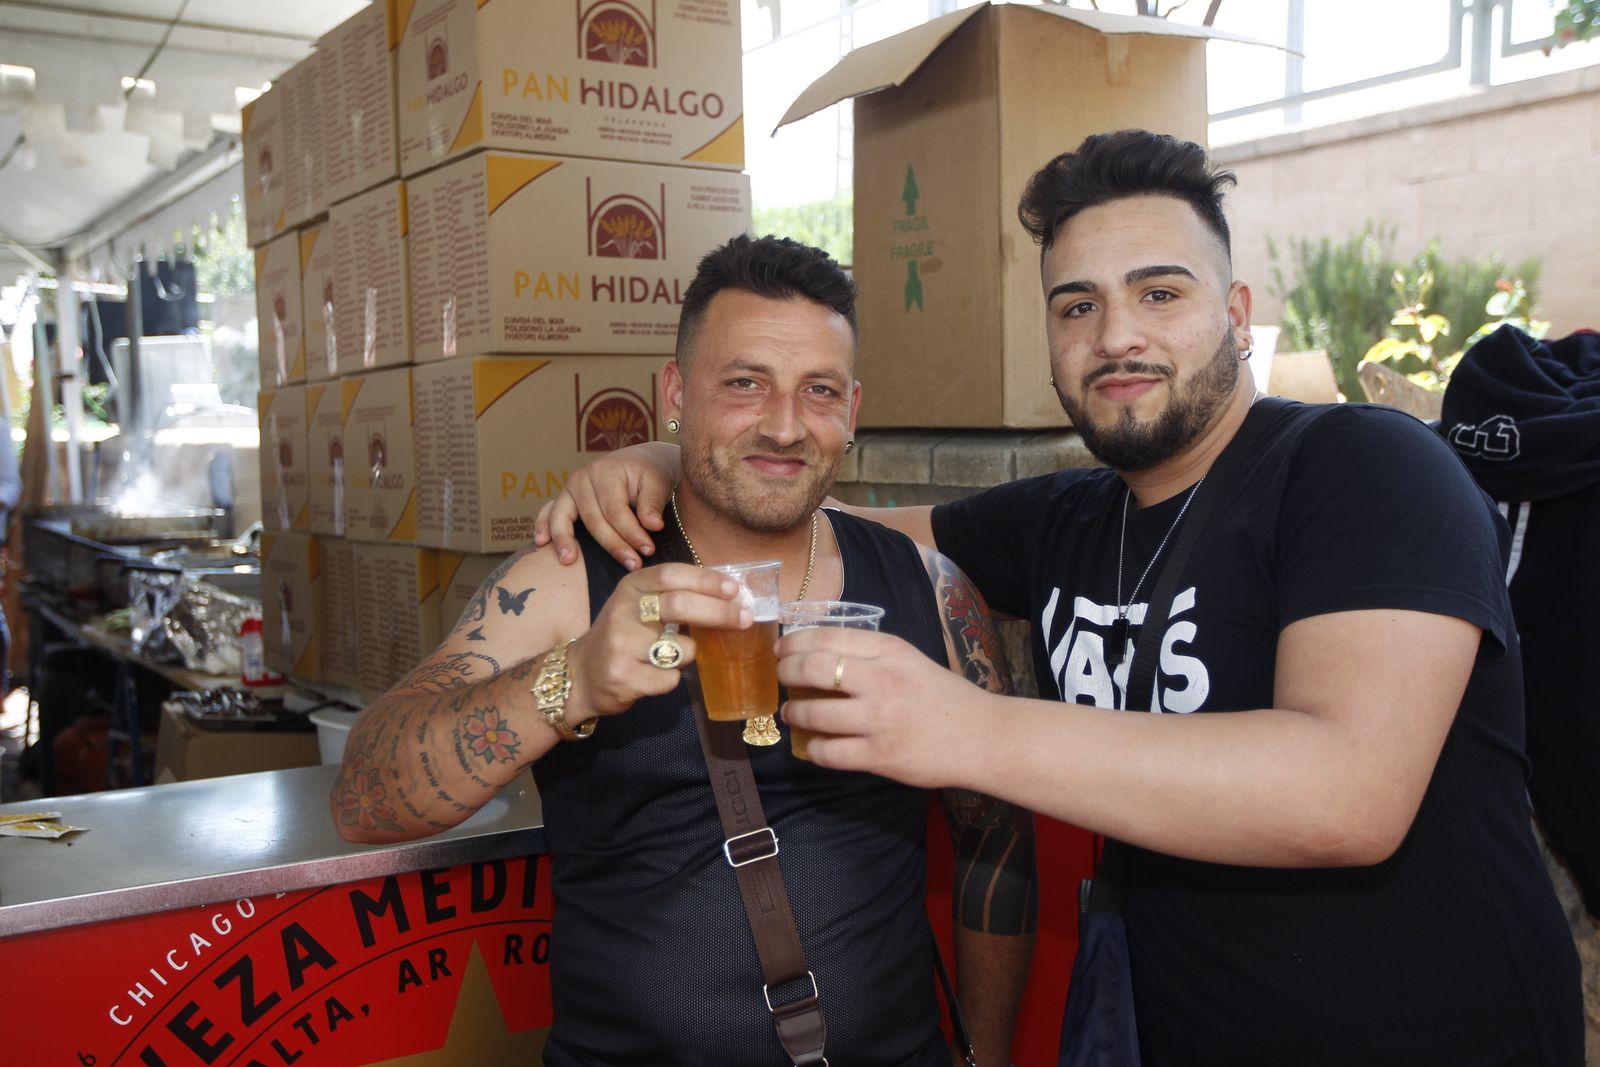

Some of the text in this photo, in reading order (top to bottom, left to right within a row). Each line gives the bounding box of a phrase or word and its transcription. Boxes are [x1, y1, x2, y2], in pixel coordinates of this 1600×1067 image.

[502, 68, 724, 119] PAN HIDALGO
[890, 241, 935, 261] FRAGILE
[514, 271, 581, 300] PAN
[109, 898, 255, 1026] CHICAGO
[398, 947, 452, 994] AR
